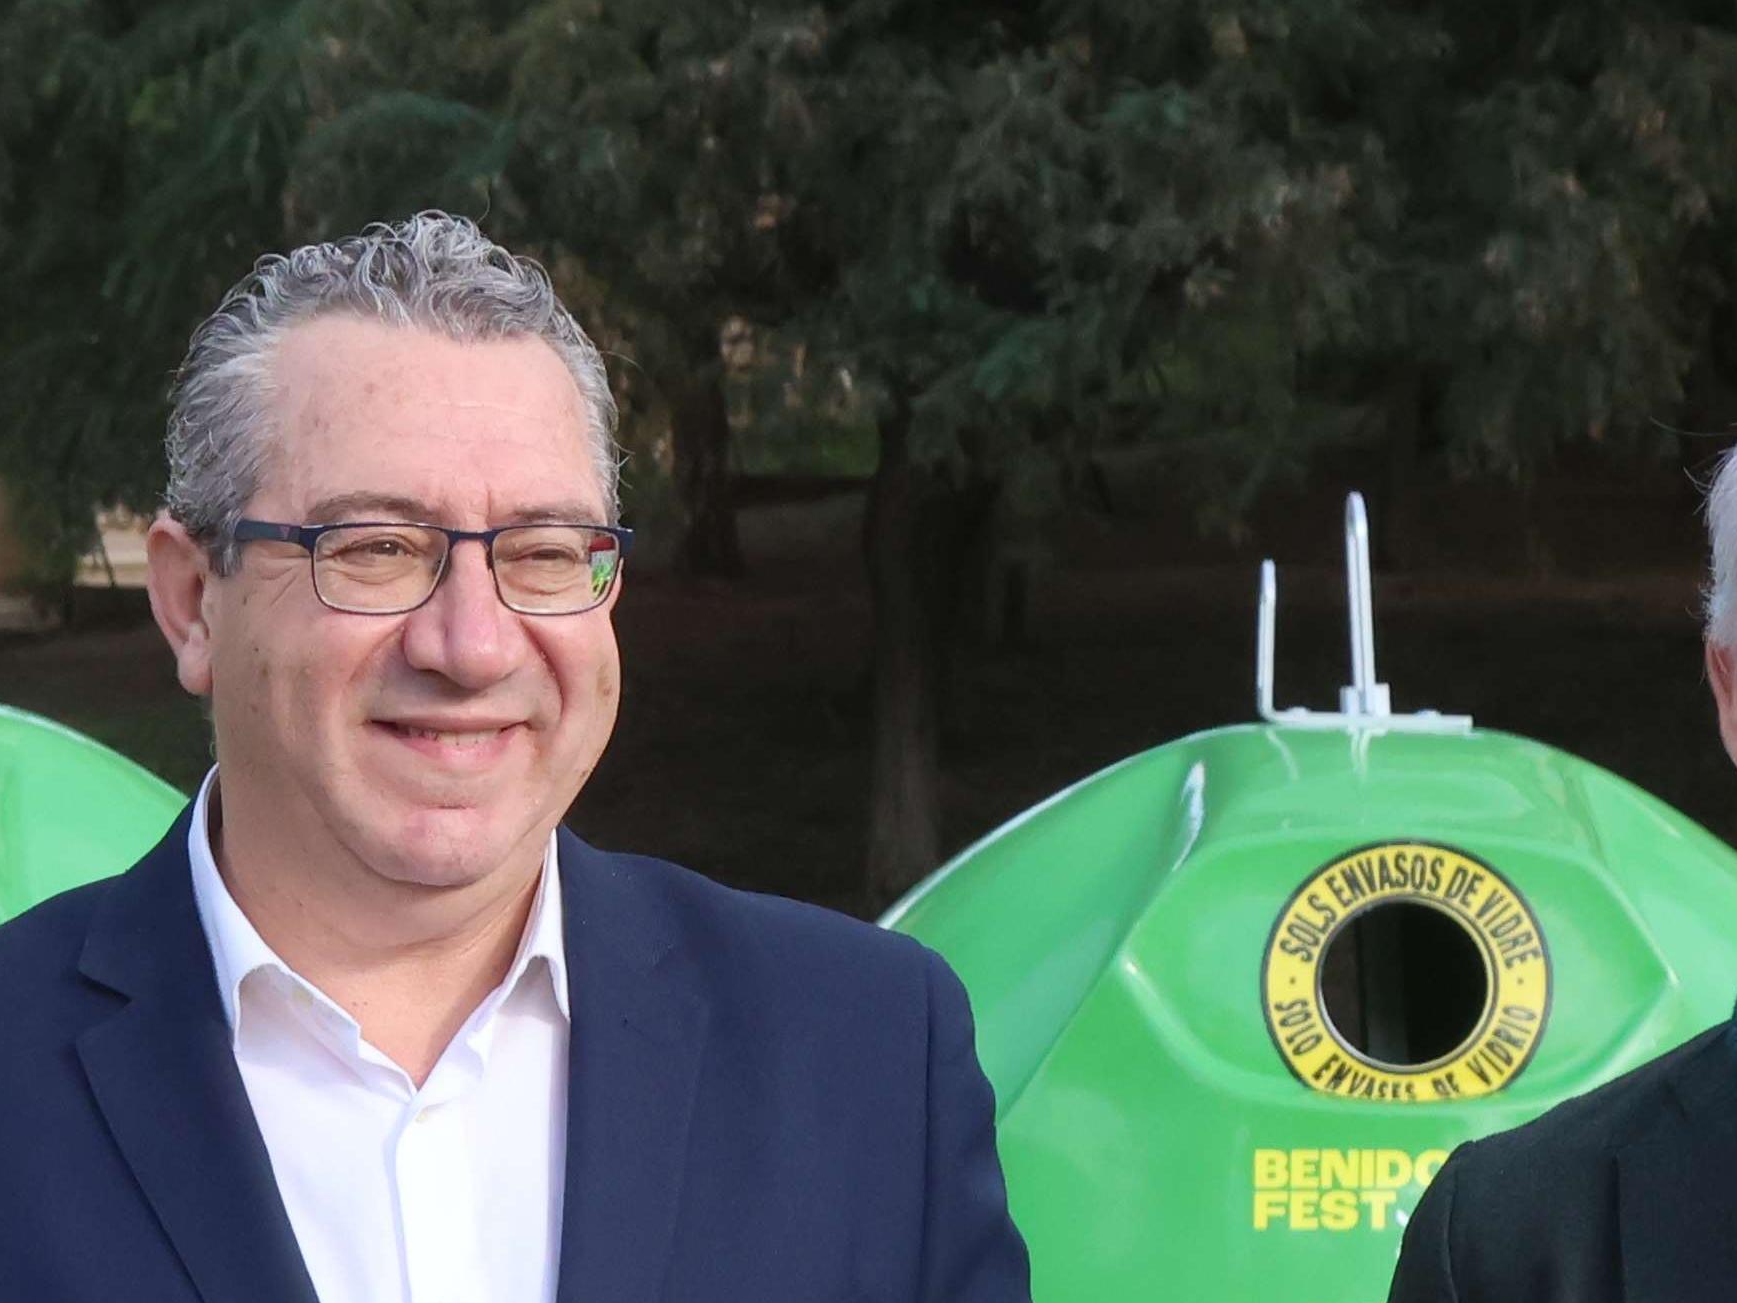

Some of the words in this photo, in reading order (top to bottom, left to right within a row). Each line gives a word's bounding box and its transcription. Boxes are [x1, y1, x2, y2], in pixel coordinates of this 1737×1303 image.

[1279, 893, 1338, 964] SOLS
[1324, 850, 1446, 909] ENVASOS
[1445, 865, 1487, 907] DE
[1474, 888, 1542, 970] VIDRE
[1273, 998, 1323, 1057] SOLO
[1466, 1004, 1537, 1087] VIDRIO
[1253, 1190, 1397, 1231] FEST
